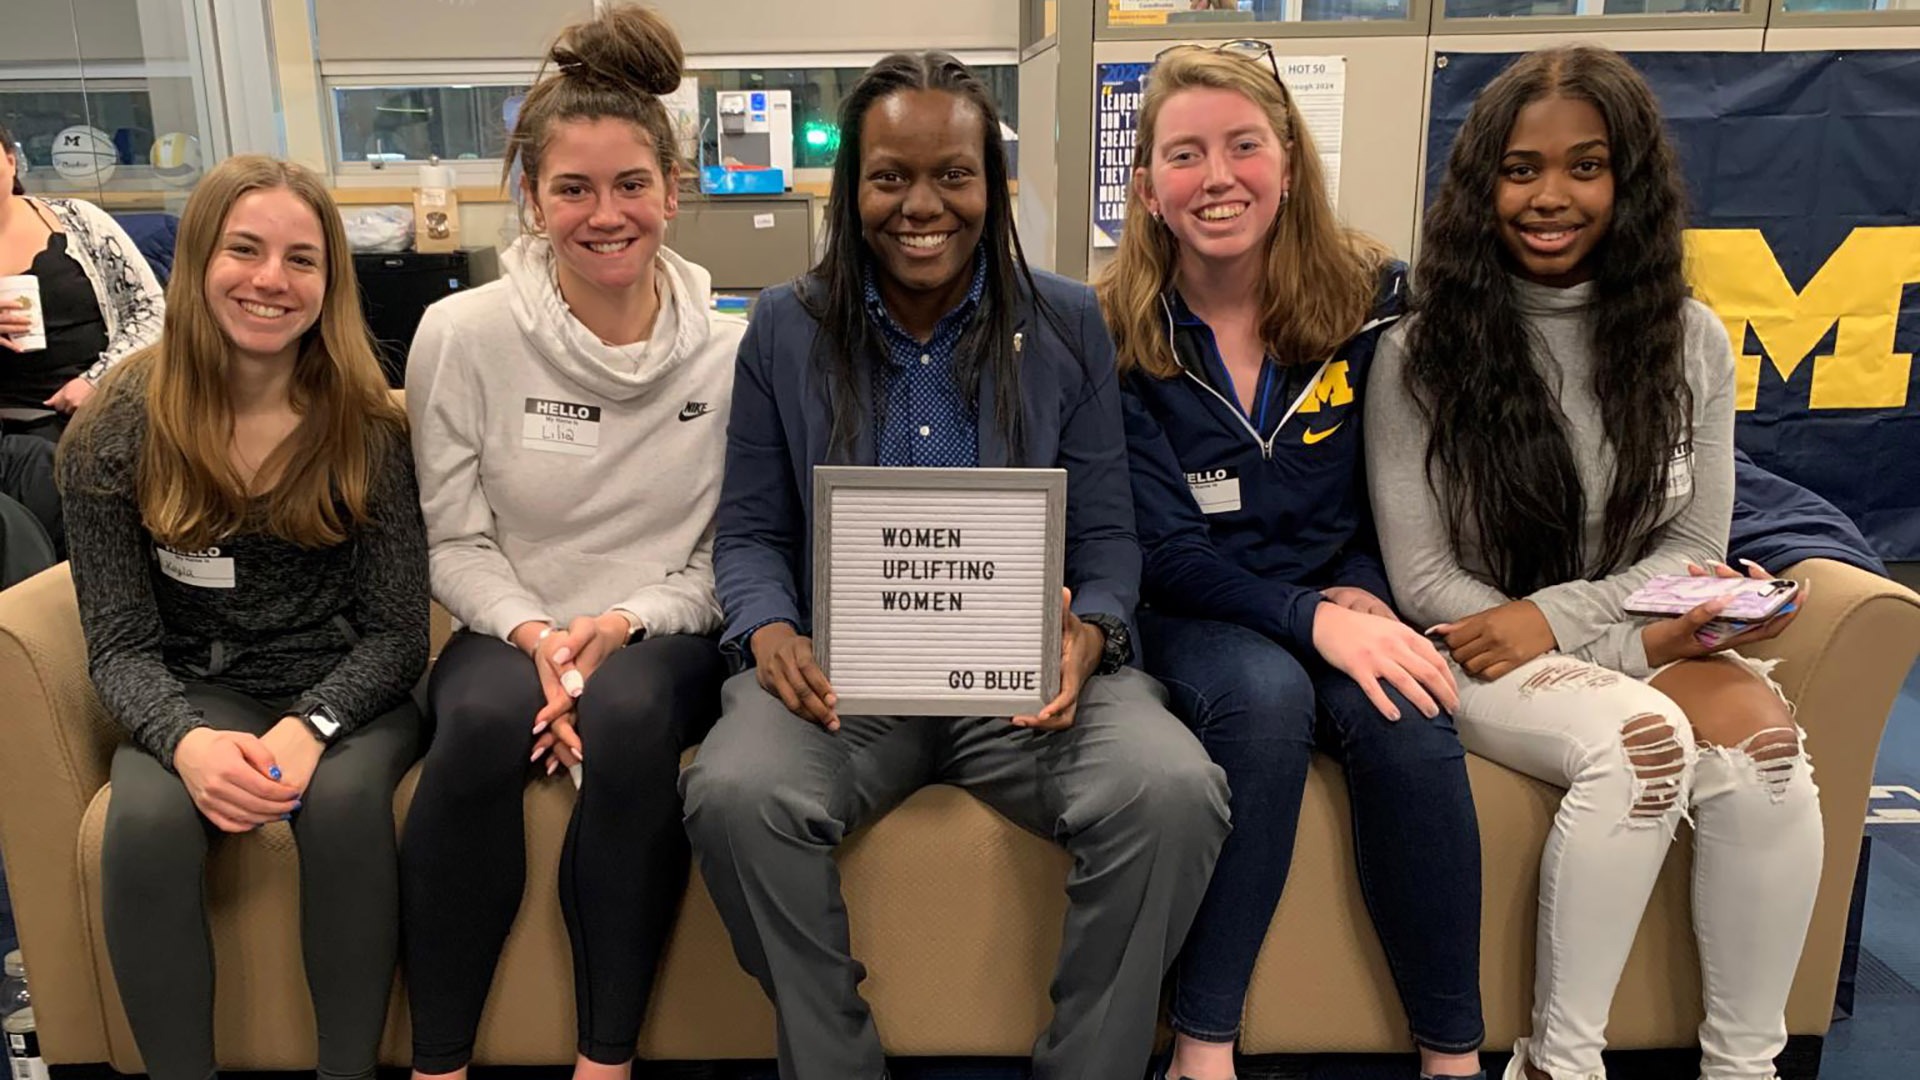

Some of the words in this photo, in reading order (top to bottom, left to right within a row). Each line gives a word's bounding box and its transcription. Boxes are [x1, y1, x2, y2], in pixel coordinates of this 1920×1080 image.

[1288, 64, 1310, 74] HOT
[1312, 64, 1326, 74] 50
[1101, 110, 1131, 130] DON'T
[64, 135, 81, 147] M
[1100, 130, 1137, 148] CREATE
[1100, 167, 1125, 184] THEY
[1100, 185, 1127, 202] MORE
[1681, 226, 1920, 410] M
[1297, 360, 1354, 413] M
[536, 401, 590, 420] HELLO
[684, 401, 708, 414] NIKE
[1183, 469, 1227, 483] ELLO
[882, 528, 961, 548] WOMEN
[883, 560, 995, 580] UPLIFTING
[882, 591, 963, 611] WOMEN
[949, 671, 975, 689] GO
[984, 671, 1036, 690] BLUE
